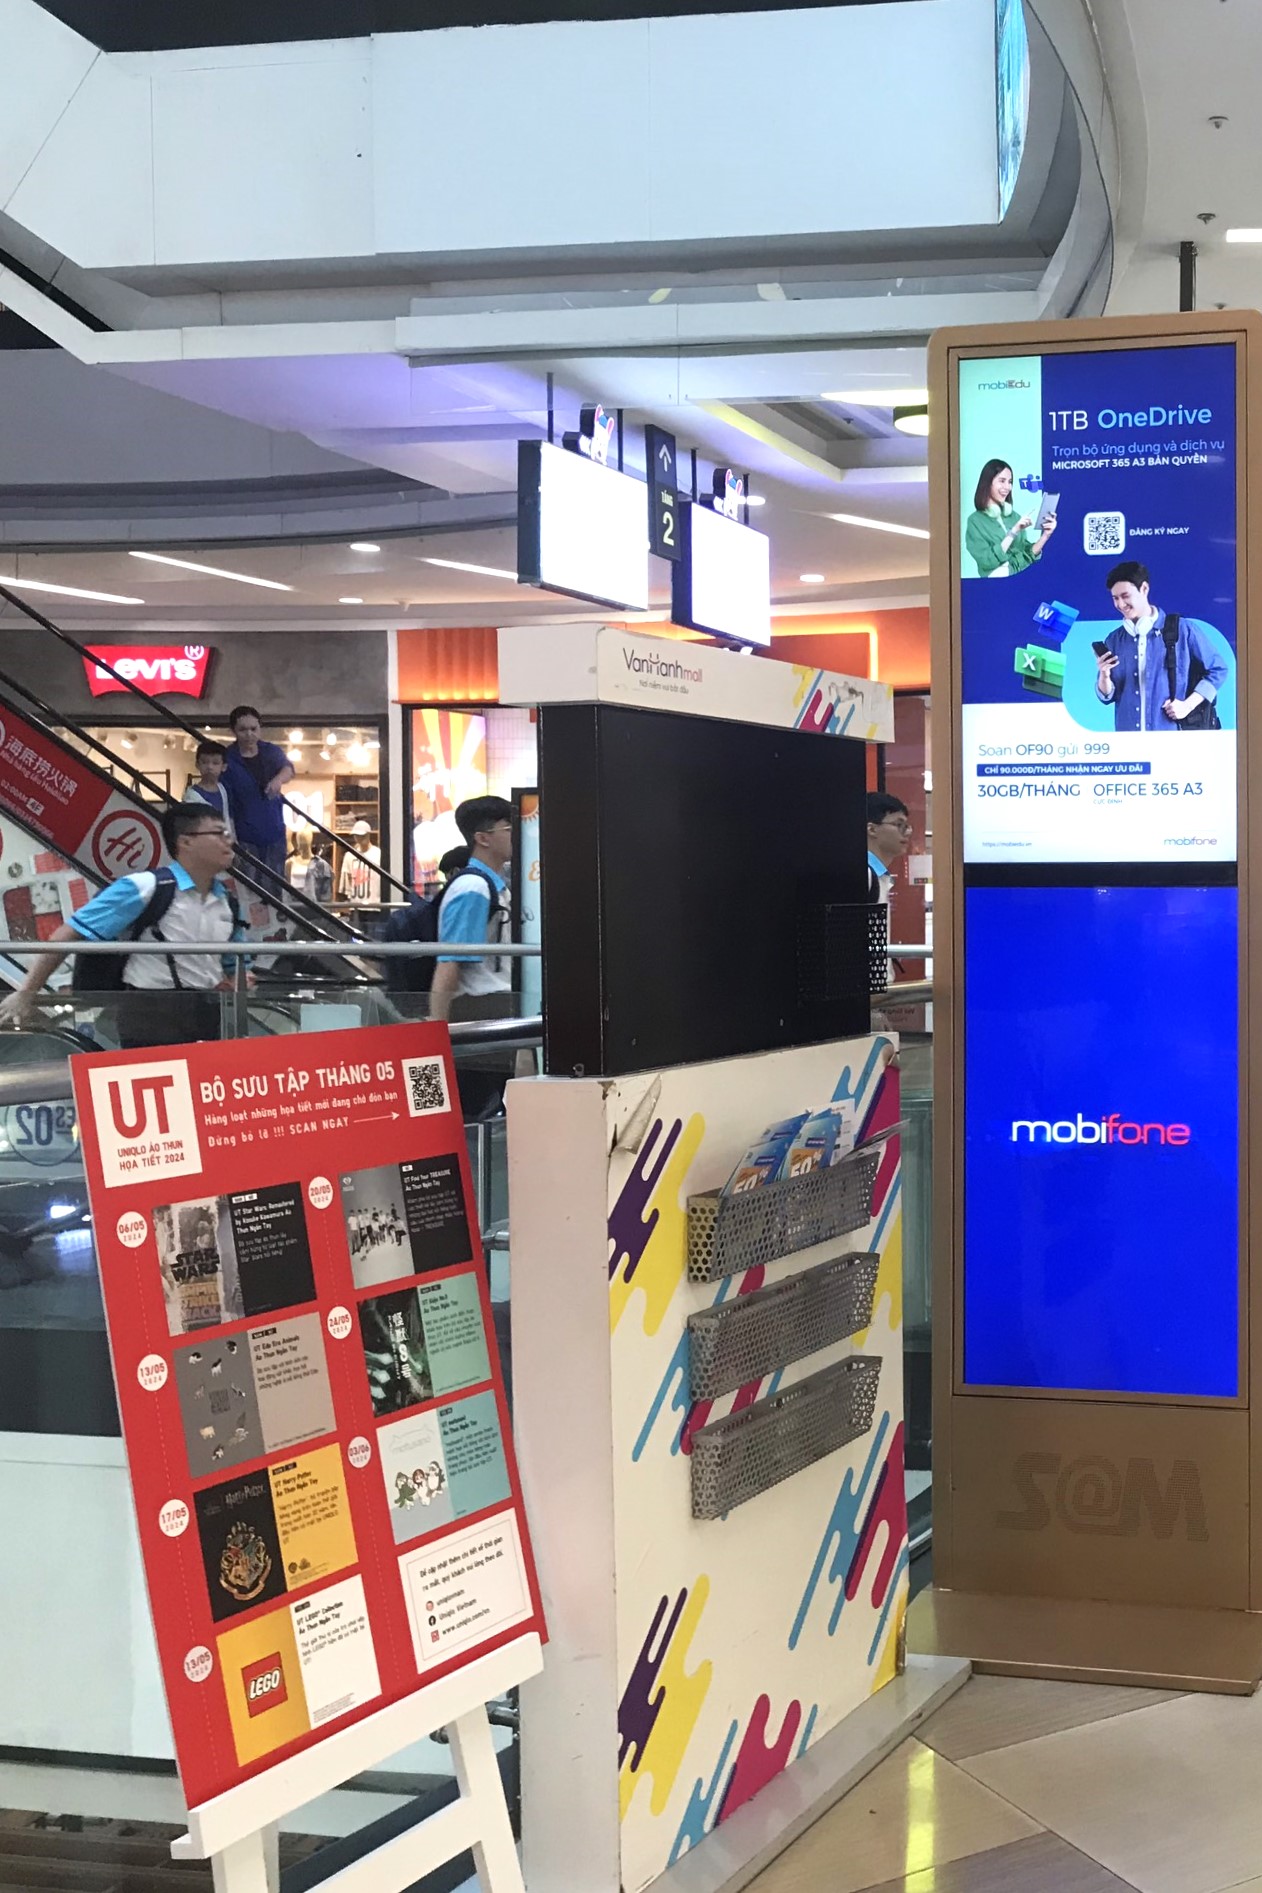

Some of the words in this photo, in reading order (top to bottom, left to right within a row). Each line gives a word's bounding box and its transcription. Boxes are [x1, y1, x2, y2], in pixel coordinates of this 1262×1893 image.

[1049, 410, 1089, 432] 1TB
[1097, 404, 1212, 429] OneDrive
[1052, 445, 1080, 459] Trọn
[1083, 444, 1099, 457] bộ
[1101, 443, 1125, 456] ứng
[1128, 442, 1161, 455] dụng
[1163, 440, 1177, 452] và
[1180, 439, 1208, 453] dịch
[1210, 440, 1225, 451] vụ
[1052, 459, 1111, 471] MICROSOFT
[1112, 458, 1130, 468] 365
[1132, 457, 1146, 467] A3
[1172, 452, 1208, 467] QUYỀN
[663, 511, 675, 546] 2
[1129, 527, 1153, 537] ĐĂNG
[1167, 526, 1190, 536] NGAY
[1038, 606, 1054, 621] W
[1022, 653, 1036, 671] X
[1016, 744, 1054, 756] OF90
[1084, 743, 1110, 754] 999
[1091, 765, 1113, 773] NGAY
[978, 780, 1081, 798] 30GB/THÁNG
[1093, 783, 1147, 797] OFFICE
[1152, 782, 1179, 796] 365
[1183, 782, 1203, 796] A3
[1164, 836, 1217, 846] mobifone
[200, 1075, 225, 1107] BỘ
[231, 1075, 269, 1099] SƯU
[274, 1066, 309, 1098] TẬP
[315, 1060, 371, 1089] THÁNG
[376, 1061, 395, 1081] 05
[108, 1075, 174, 1139] UT
[204, 1113, 228, 1127] Hàng
[231, 1109, 248, 1124] loạt
[251, 1105, 277, 1120] những
[280, 1104, 295, 1118] họa
[297, 1100, 313, 1114] tiết
[315, 1099, 330, 1111] mới
[332, 1096, 351, 1109] đang
[384, 1090, 398, 1102] bạn
[208, 1134, 237, 1148] Đừng
[241, 1130, 254, 1143] bỏ
[273, 1125, 285, 1137] !!!
[289, 1121, 318, 1135] SCAN
[322, 1116, 349, 1130] NGAY
[1011, 1112, 1191, 1145] mobifone
[117, 1144, 147, 1158] UNIQLO
[149, 1140, 160, 1154] ÁO
[162, 1139, 184, 1152] THUN
[119, 1157, 139, 1173] HỌA
[142, 1152, 162, 1168] TIẾT
[165, 1151, 185, 1165] 2024
[119, 1220, 145, 1234] 06/05
[139, 1362, 165, 1377] 13/05
[161, 1507, 187, 1523] 17/05
[185, 1651, 211, 1672] 13/05
[249, 1667, 281, 1699] LEGO
